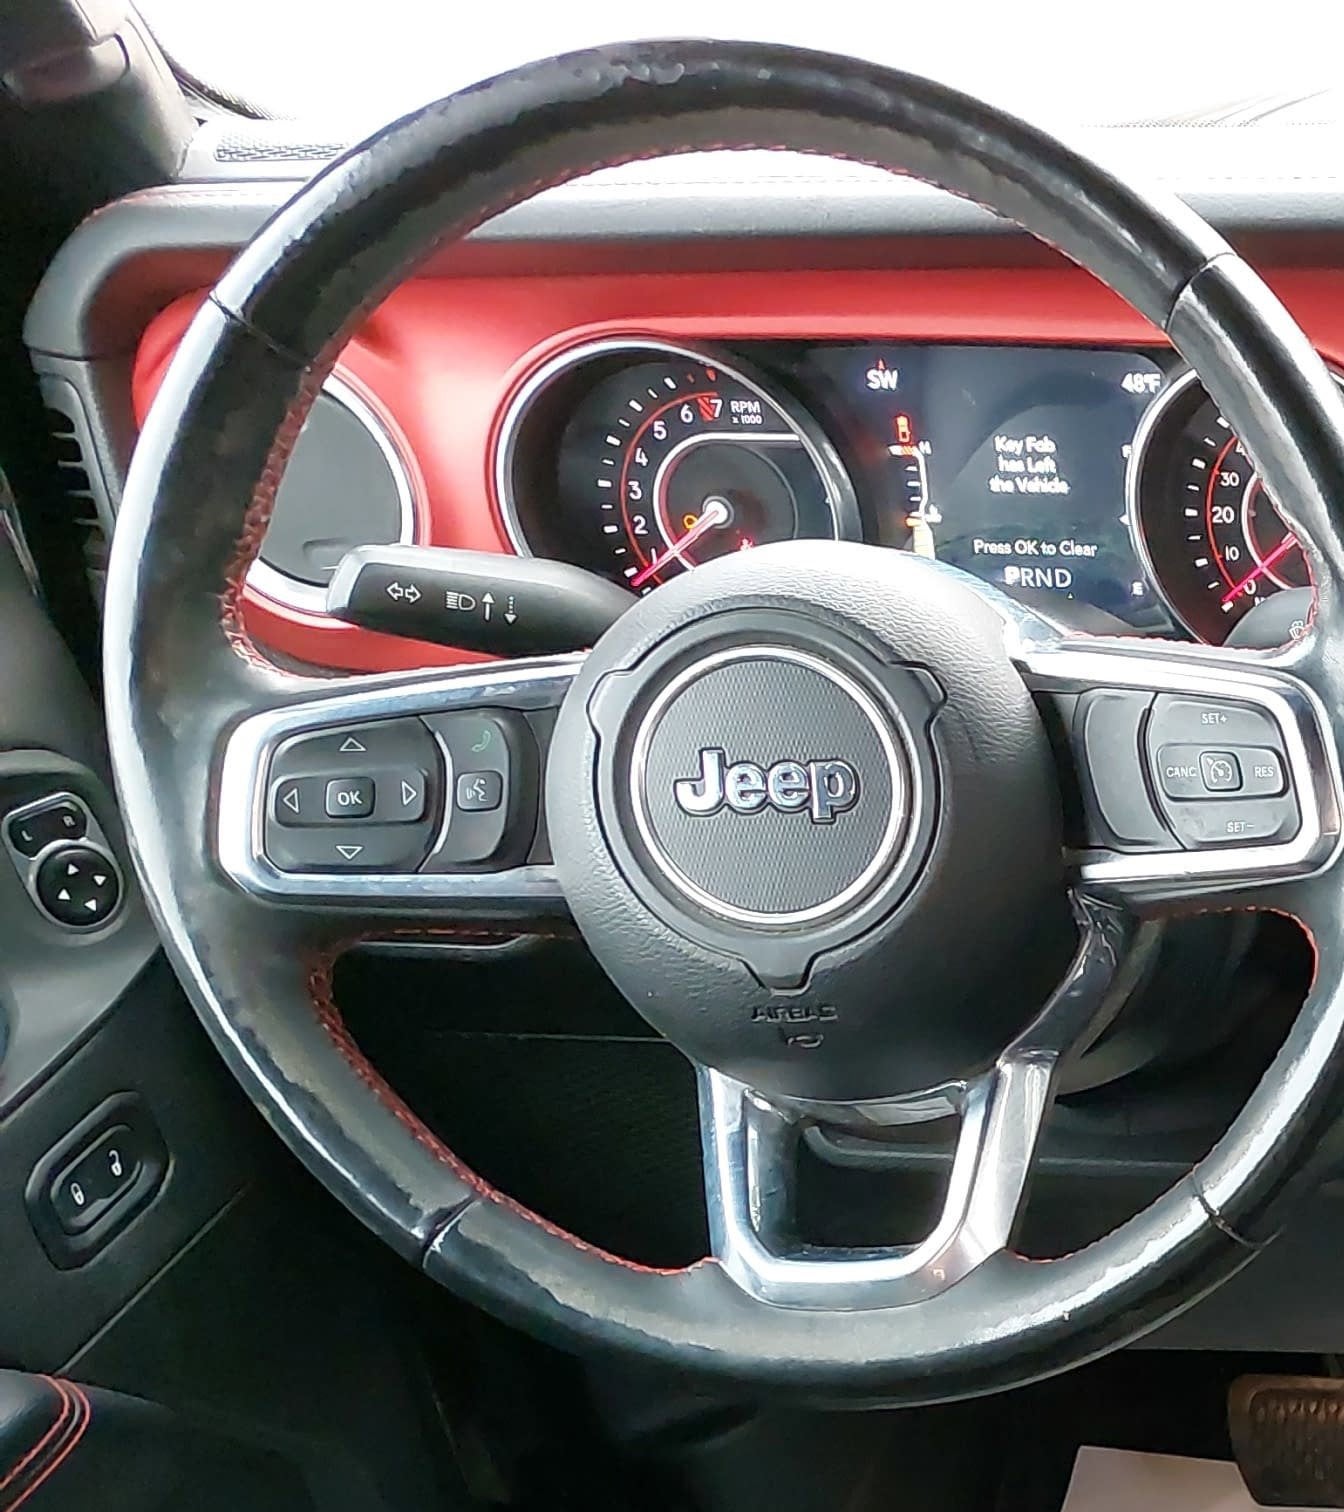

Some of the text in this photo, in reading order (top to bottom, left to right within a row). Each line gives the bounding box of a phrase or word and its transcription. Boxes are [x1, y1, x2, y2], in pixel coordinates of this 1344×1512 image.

[866, 369, 898, 390] SW
[680, 405, 694, 423] 6
[709, 399, 723, 418] 7
[731, 401, 761, 414] RPM
[741, 415, 762, 424] 1000
[653, 421, 667, 440] 5
[994, 435, 1057, 456] Key Fob
[635, 448, 648, 466] 4
[999, 454, 1025, 472] has
[989, 475, 1015, 493] the
[1220, 472, 1240, 487] 30
[628, 481, 642, 499] 3
[1212, 506, 1235, 524] 20
[633, 515, 648, 535] 2
[974, 539, 1098, 557] Press OK to Clear
[1225, 546, 1239, 561] 10
[1255, 766, 1274, 778] RES
[675, 747, 858, 824] Jeep
[336, 789, 362, 808] OK
